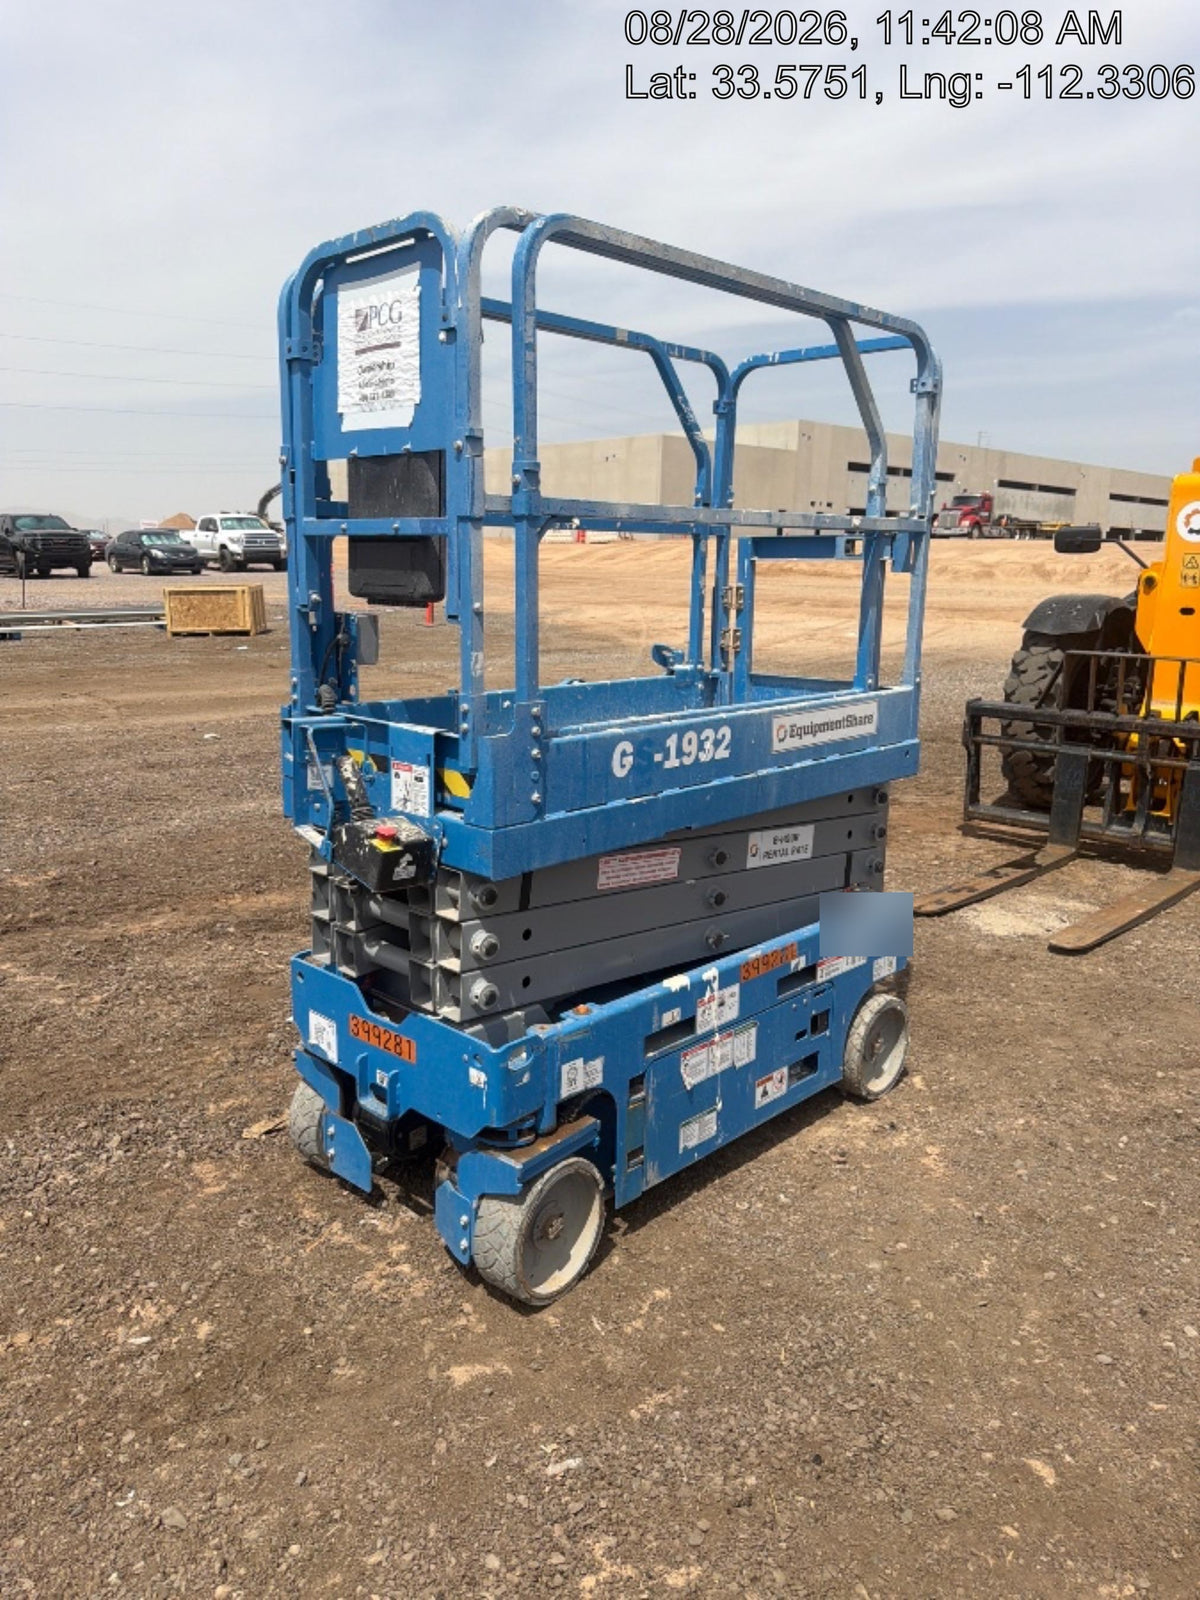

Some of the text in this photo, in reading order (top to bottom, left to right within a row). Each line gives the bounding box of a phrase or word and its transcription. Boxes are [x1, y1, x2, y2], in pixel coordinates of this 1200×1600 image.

[368, 300, 403, 330] PCG
[789, 713, 874, 740] EquipmentShare
[351, 1014, 412, 1061] 399281
